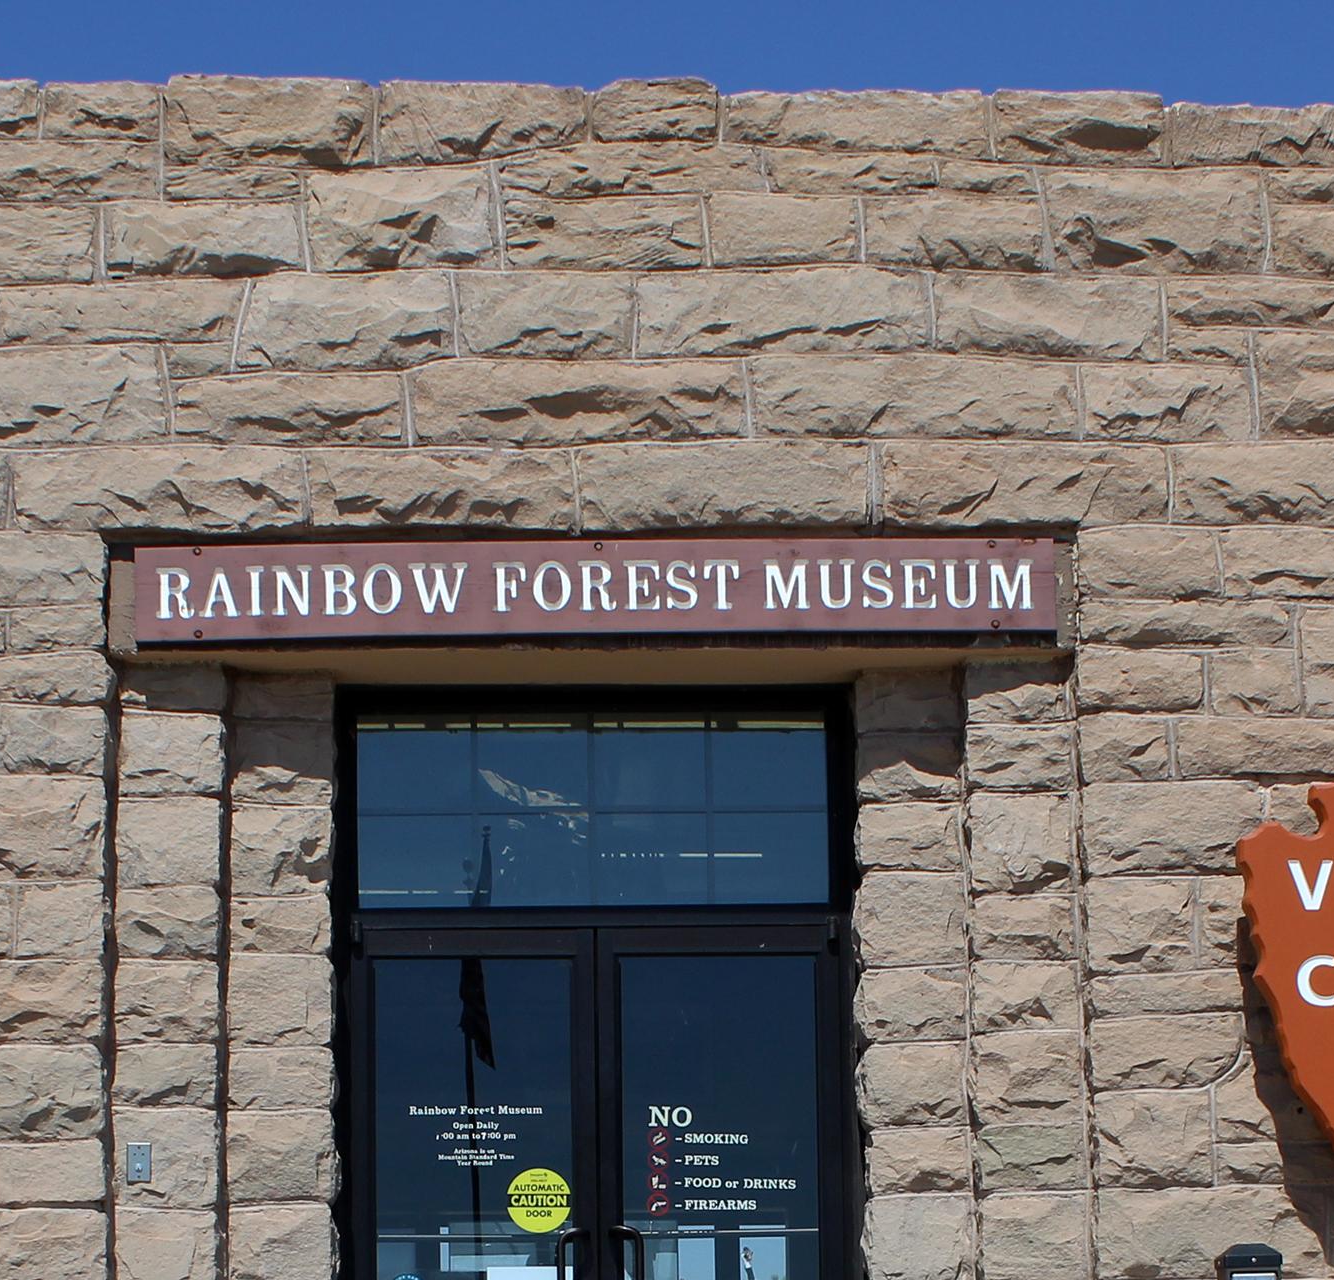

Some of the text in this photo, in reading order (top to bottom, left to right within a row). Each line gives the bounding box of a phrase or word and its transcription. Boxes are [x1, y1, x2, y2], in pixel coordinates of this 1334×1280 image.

[156, 558, 1036, 620] RAINBOW FOREST MUSEUM
[408, 1105, 457, 1116] Rainbow
[498, 1105, 544, 1115] Museum
[648, 1105, 693, 1128] NO
[452, 1121, 500, 1131] Open Daily
[503, 1133, 517, 1141] pm
[684, 1133, 749, 1145] SMOKING
[684, 1155, 720, 1166] PETS
[513, 1183, 565, 1192] AUTOMATIC
[684, 1177, 722, 1188] FOOD
[724, 1180, 740, 1189] or
[743, 1178, 797, 1190] DRINKS
[511, 1195, 567, 1207] CAUTION
[684, 1199, 758, 1211] FIREARMS
[526, 1210, 553, 1218] DOOR
